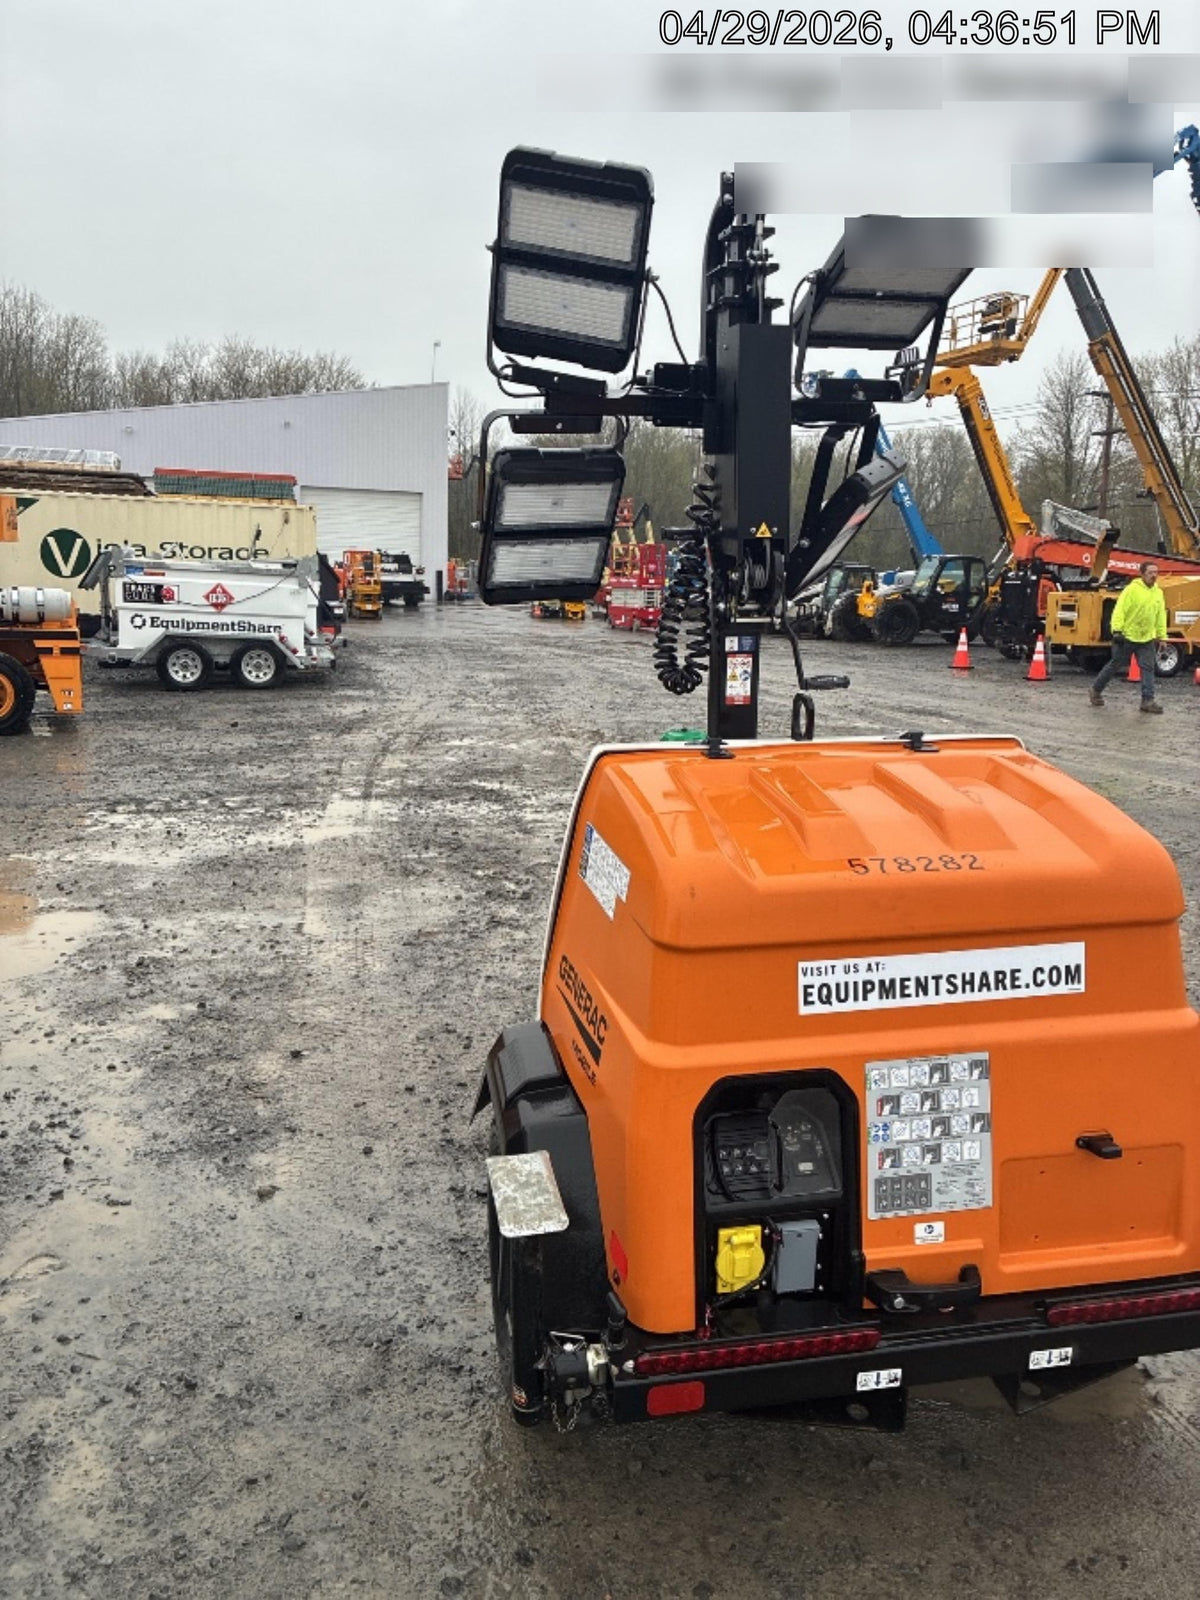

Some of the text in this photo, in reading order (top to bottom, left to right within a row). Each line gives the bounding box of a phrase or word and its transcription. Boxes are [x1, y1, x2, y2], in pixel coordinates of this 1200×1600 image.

[149, 616, 281, 634] EquipmentShare
[847, 854, 986, 875] 578282
[800, 961, 886, 977] VISIT US AT:
[803, 964, 1082, 1006] EQUIPMENTSHARE.COM
[559, 954, 609, 1044] GENERAC
